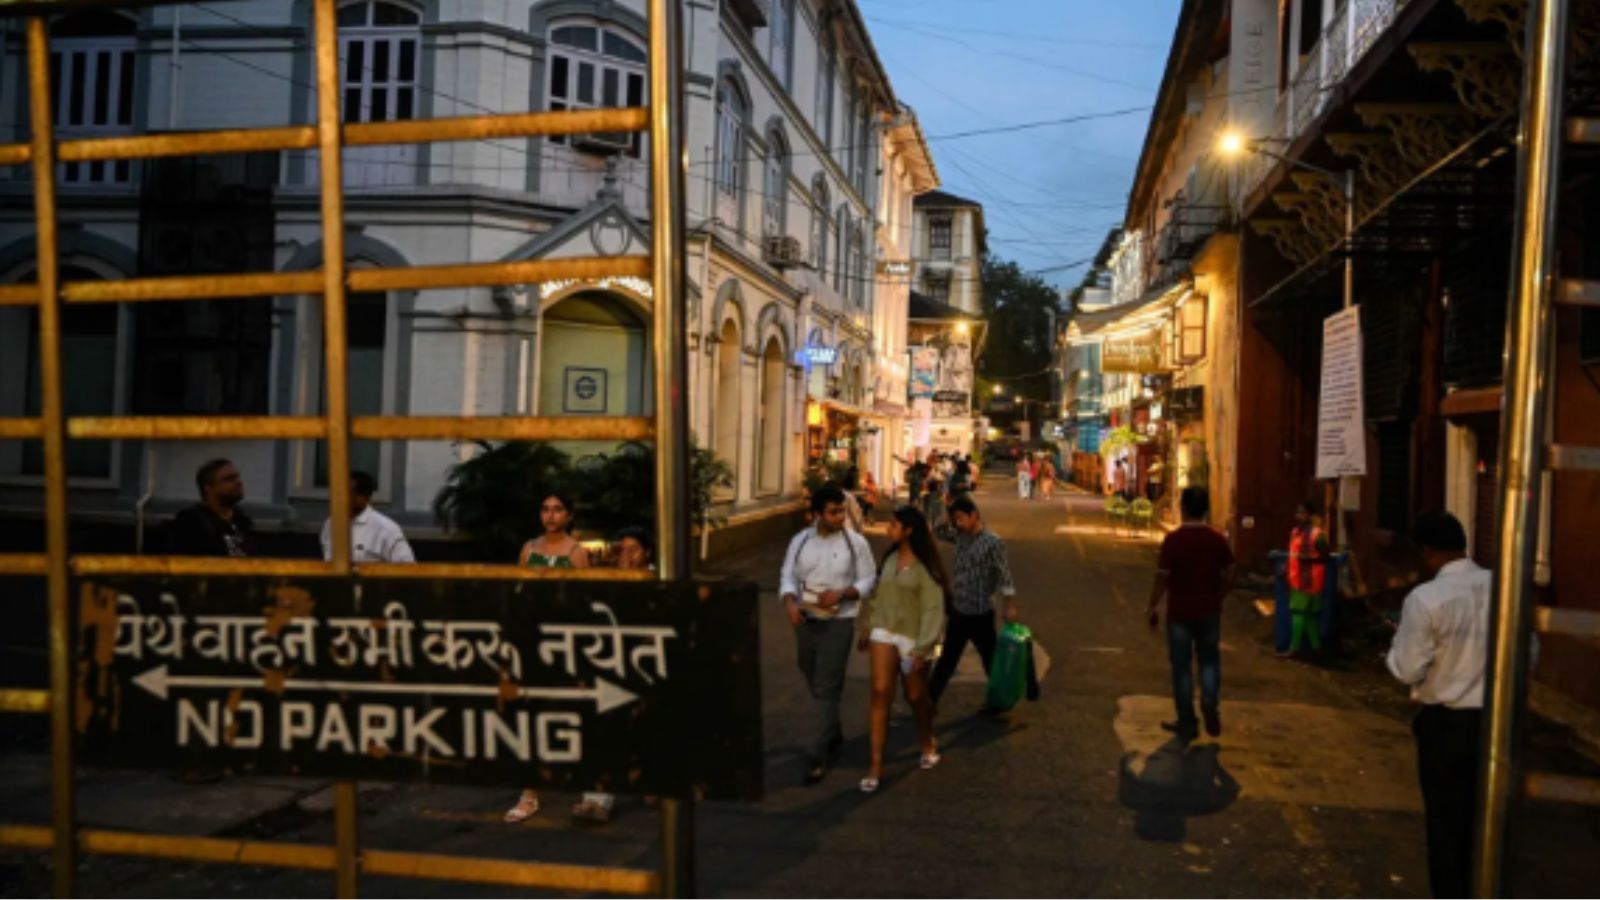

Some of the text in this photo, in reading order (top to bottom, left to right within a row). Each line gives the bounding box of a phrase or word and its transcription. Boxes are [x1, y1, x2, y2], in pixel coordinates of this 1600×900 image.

[113, 593, 187, 660] येथे
[193, 616, 320, 674] वाहन
[327, 601, 416, 668] उभी
[538, 601, 678, 685] नयेत
[177, 700, 583, 762] NO PARKING
